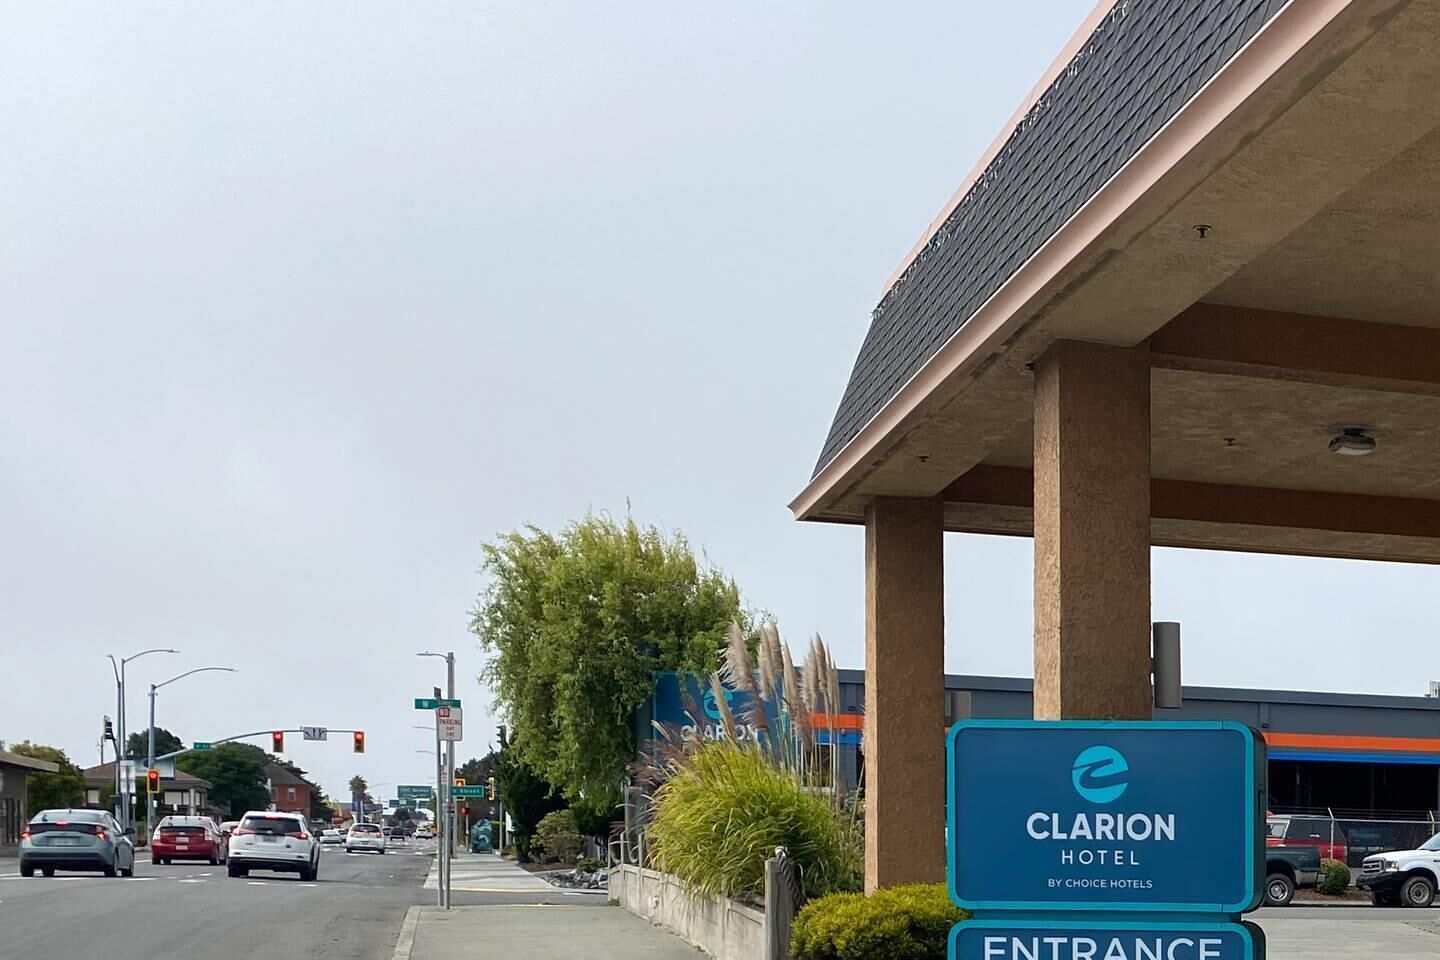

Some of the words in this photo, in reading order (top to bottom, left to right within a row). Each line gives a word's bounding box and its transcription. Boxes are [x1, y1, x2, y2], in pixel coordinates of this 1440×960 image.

[439, 708, 449, 716] NO
[1026, 812, 1175, 841] CLARION
[1061, 850, 1140, 865] HOTEL
[1048, 878, 1063, 888] BY
[1065, 878, 1108, 889] CHOICE
[1109, 879, 1153, 889] HOTELS
